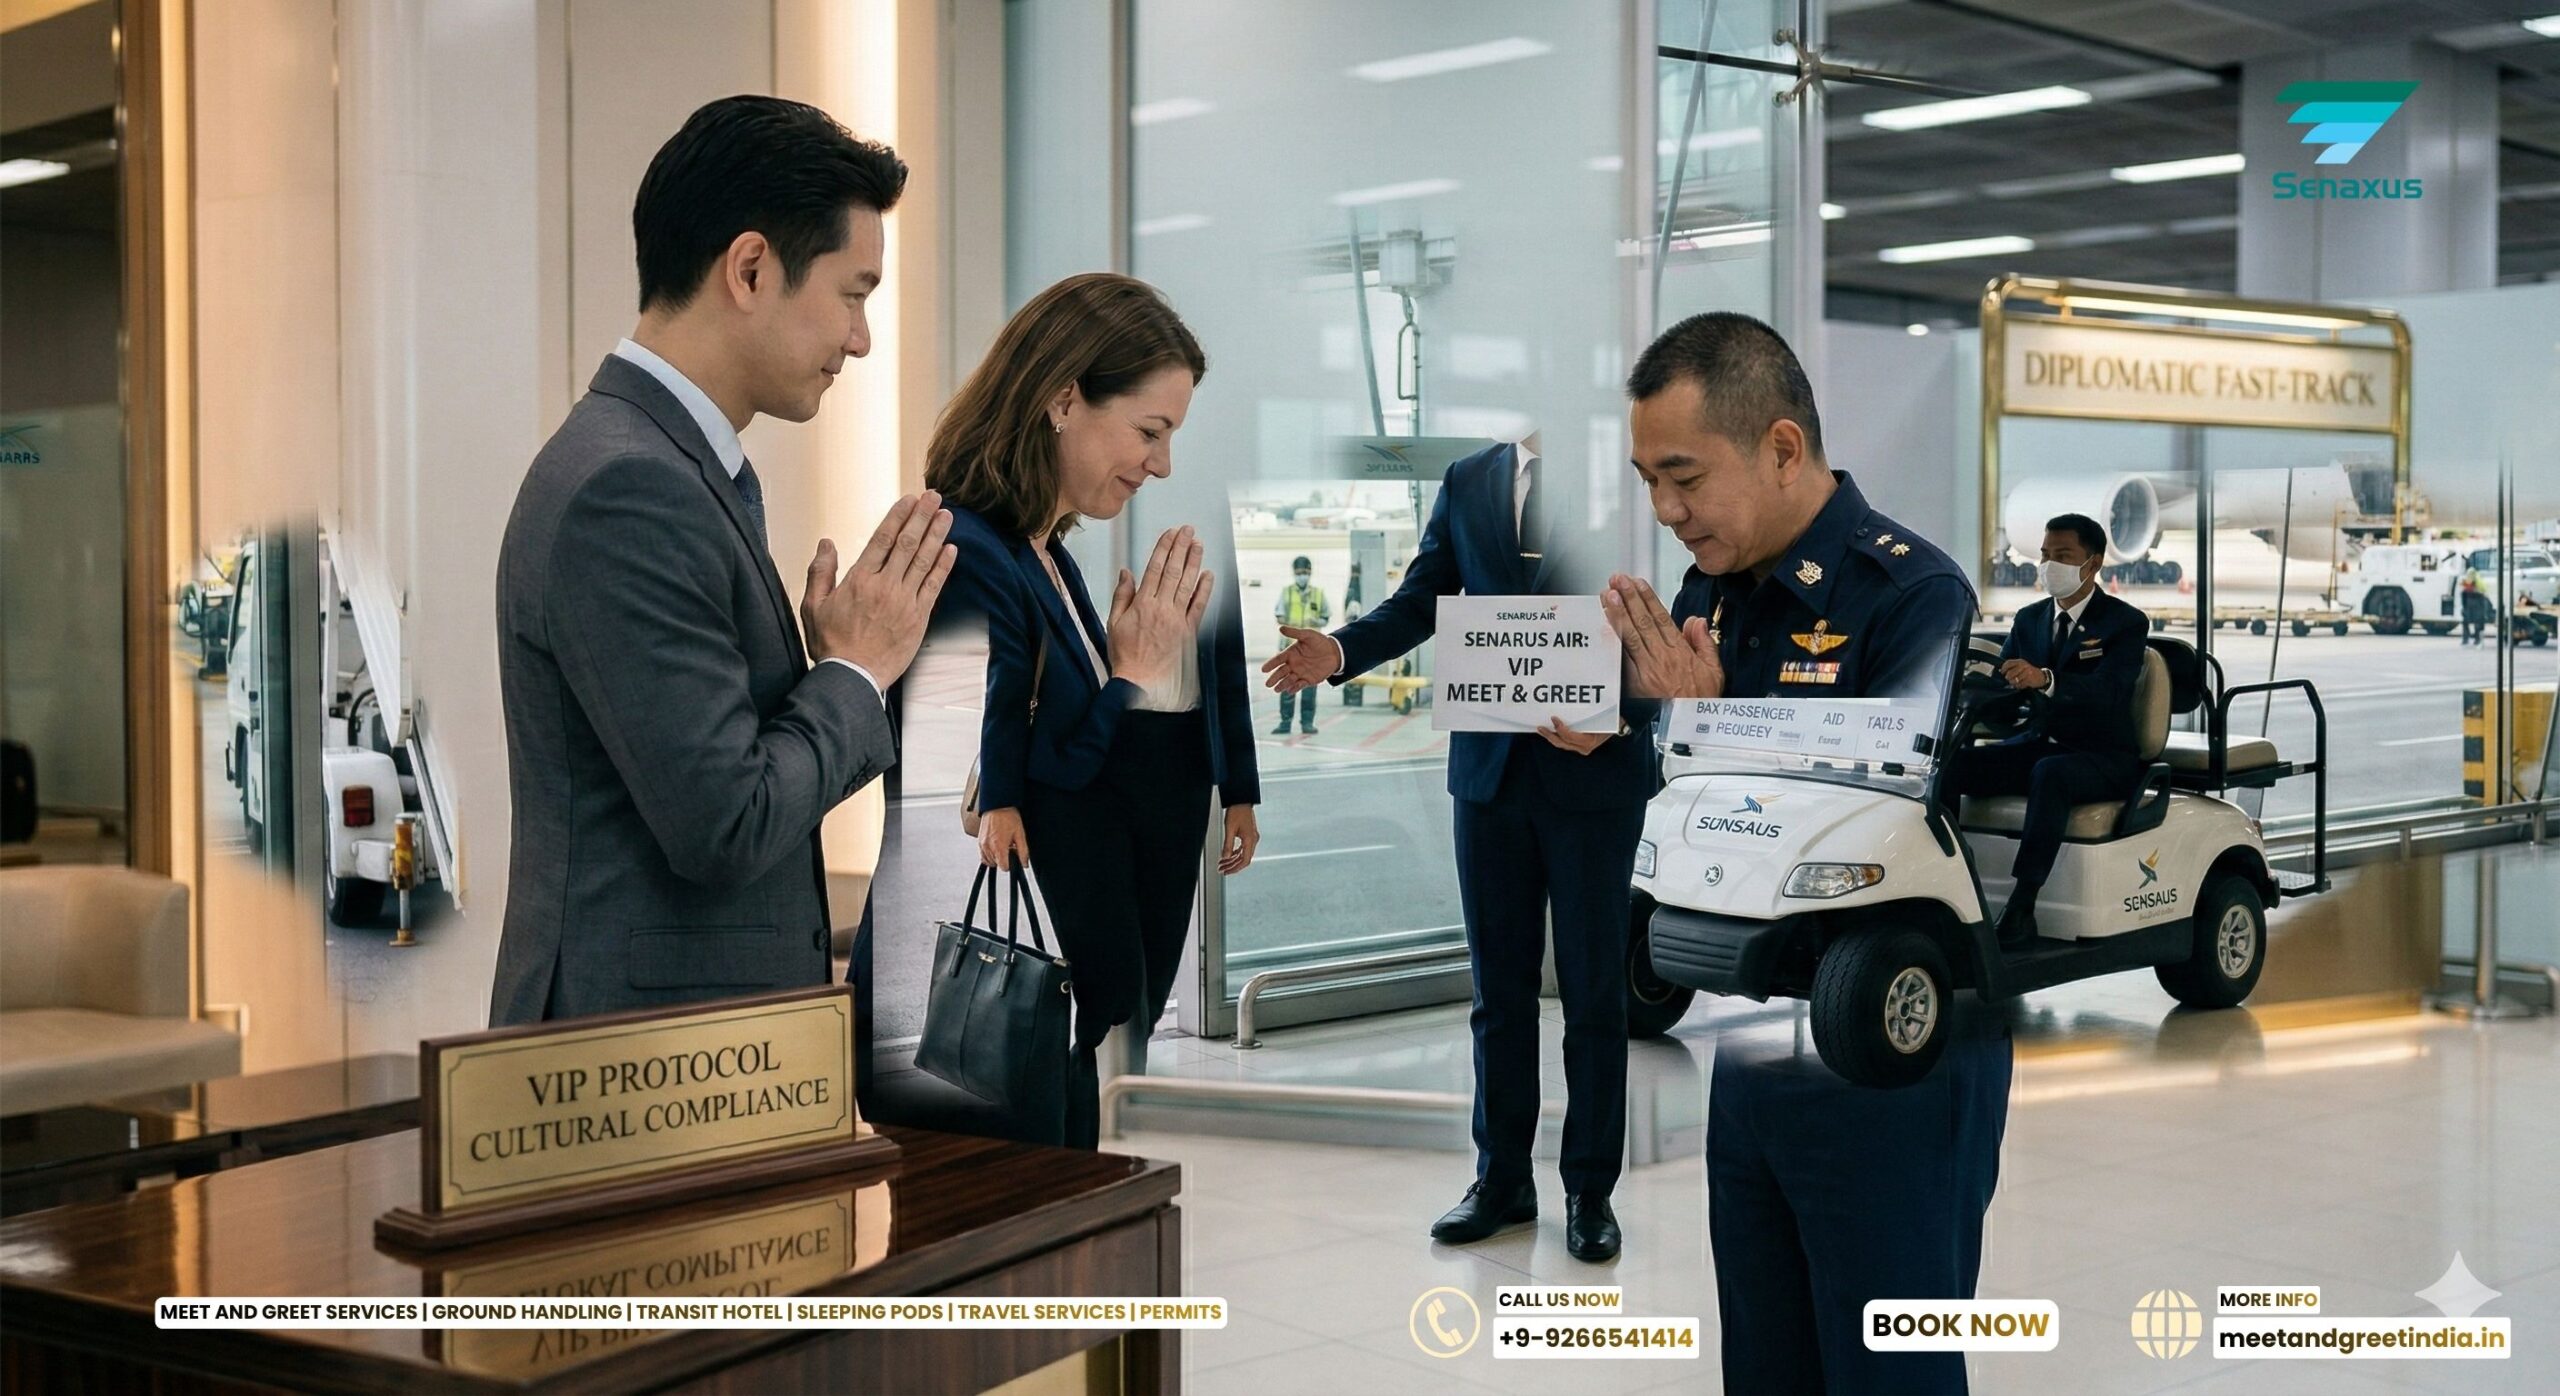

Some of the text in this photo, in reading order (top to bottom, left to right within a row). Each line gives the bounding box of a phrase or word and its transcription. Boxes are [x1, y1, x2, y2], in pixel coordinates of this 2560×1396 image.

[2023, 350, 2376, 407] DIPLOMATIC FAST-TRACK
[1496, 612, 1557, 621] SENARUS AIR
[1465, 631, 1589, 648] SENARUS AIR:
[1508, 657, 1544, 676] VIP
[1447, 683, 1605, 704] MEET & GREET
[1822, 712, 1846, 726] AID
[527, 1040, 782, 1107] VIP PROTOCOL
[470, 1077, 830, 1163] CULTURAL COMPLIANCE
